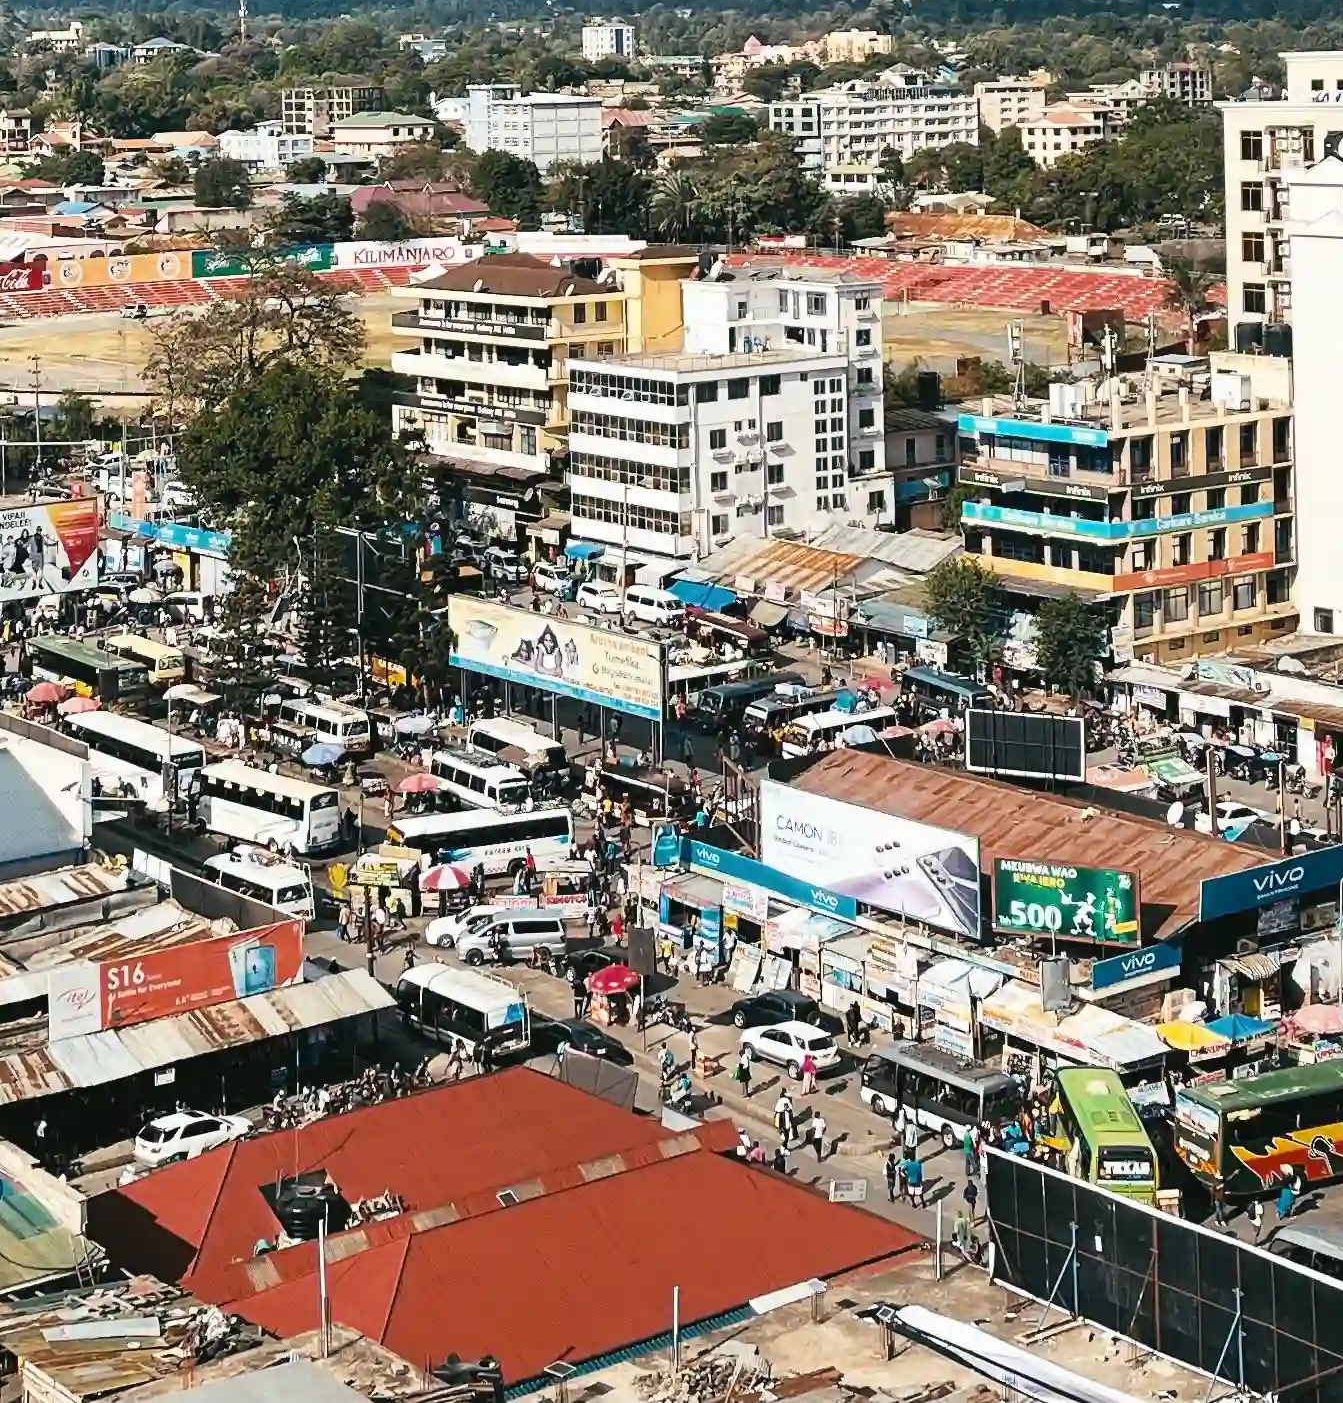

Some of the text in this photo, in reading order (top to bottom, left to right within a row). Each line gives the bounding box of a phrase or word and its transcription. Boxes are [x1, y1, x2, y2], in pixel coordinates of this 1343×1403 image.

[353, 246, 455, 264] KILIMANJARO
[776, 814, 823, 841] CAMON
[697, 848, 720, 863] vivo
[1051, 865, 1078, 879] WAO
[1252, 866, 1305, 891] vivo
[810, 889, 839, 909] vivo
[1010, 900, 1062, 931] 500
[1121, 953, 1156, 971] vivo
[107, 961, 145, 990] S16
[149, 978, 182, 992] Everyone
